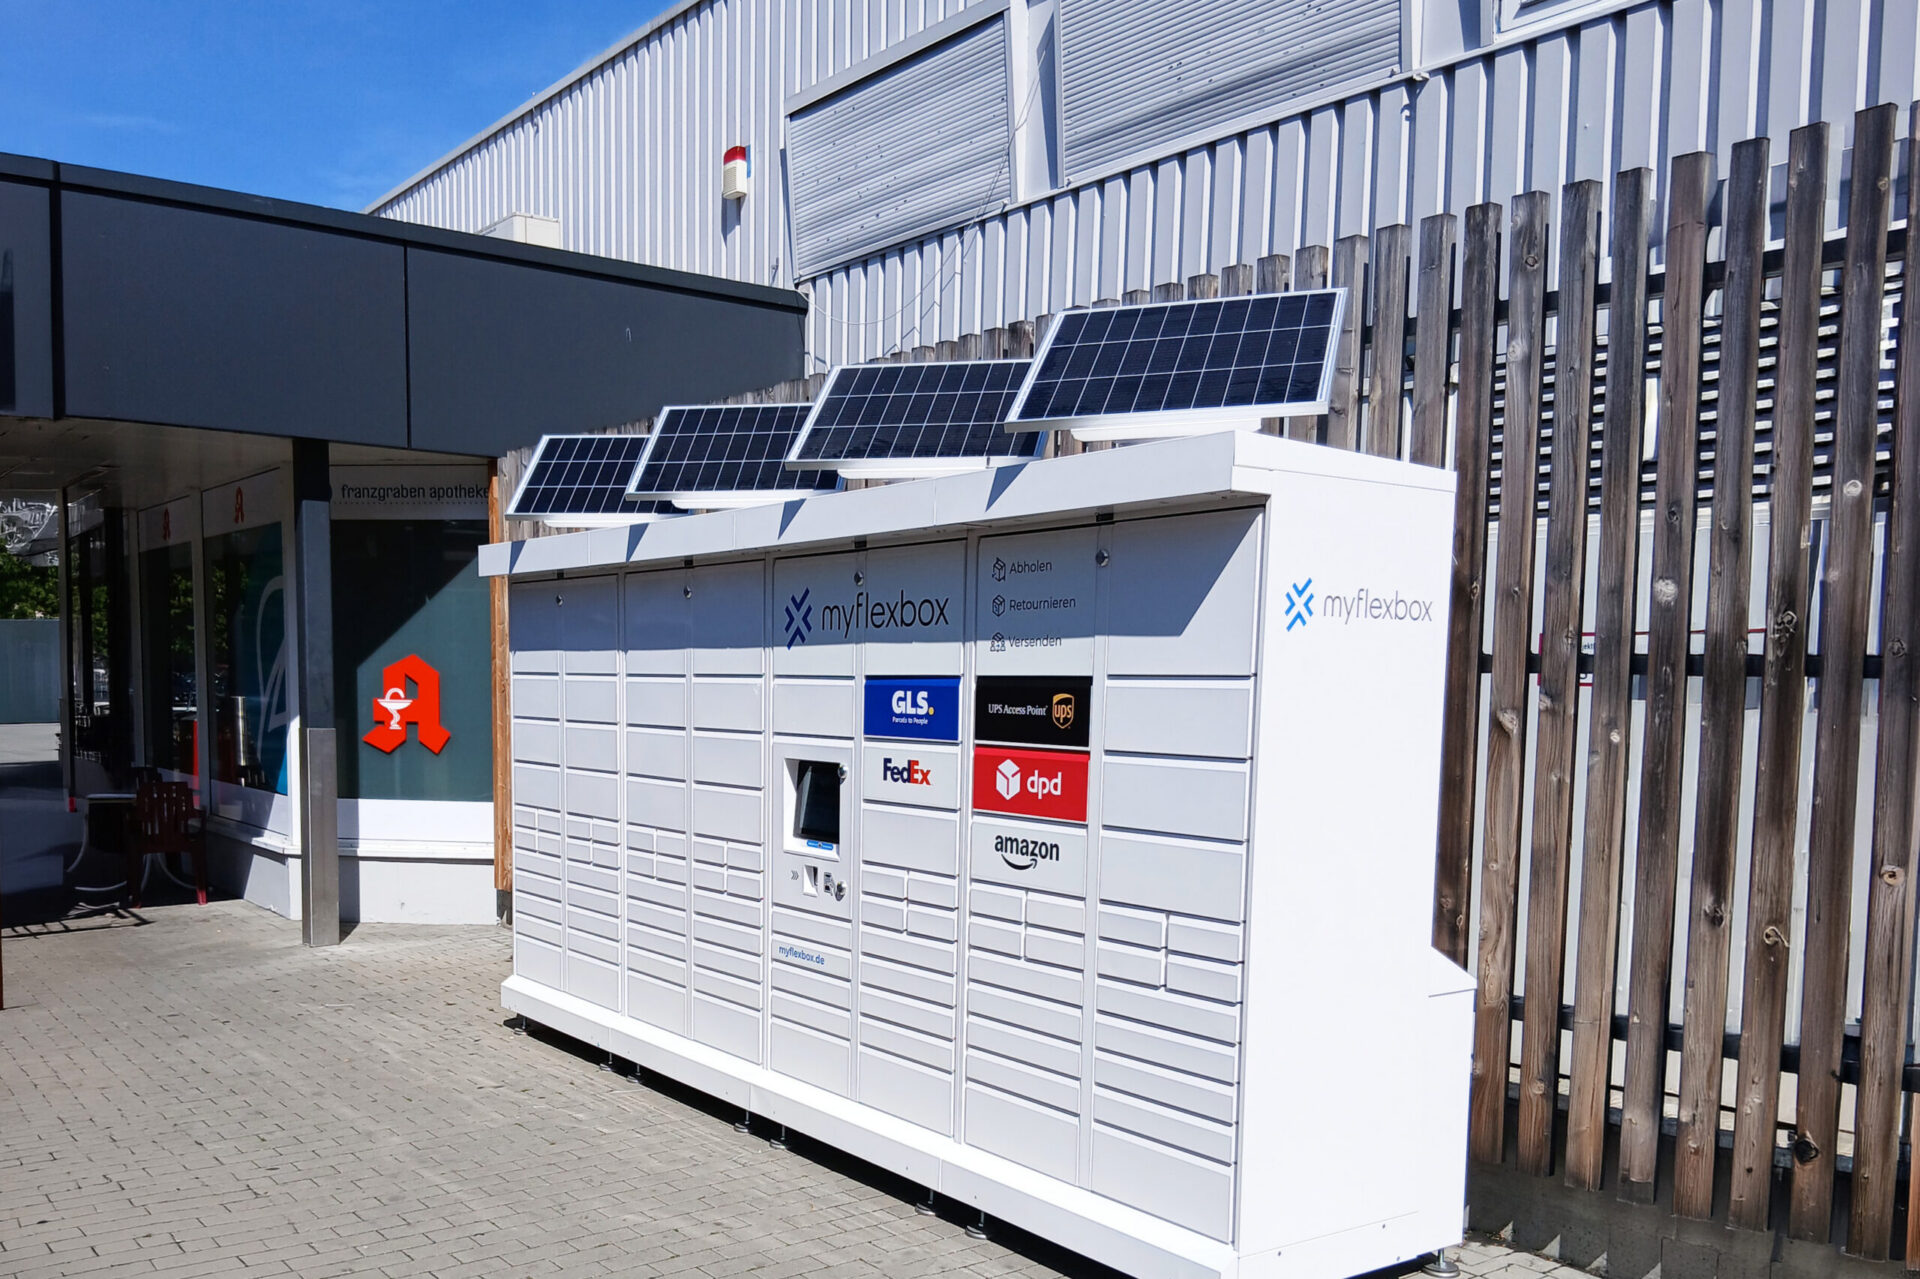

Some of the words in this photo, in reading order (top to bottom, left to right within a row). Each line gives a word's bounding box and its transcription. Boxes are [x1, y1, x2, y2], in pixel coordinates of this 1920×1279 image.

[341, 484, 425, 501] franzgraben
[1009, 560, 1052, 575] Abholen
[1009, 596, 1076, 611] Retournieren
[1323, 588, 1433, 625] myflexbox
[822, 589, 949, 638] myflexbox
[1008, 634, 1062, 648] Versenden
[988, 703, 1003, 714] UPS
[1003, 704, 1026, 715] Access
[1026, 704, 1046, 716] Point
[883, 758, 931, 785] FedEx
[1026, 770, 1062, 800] dpd
[994, 834, 1060, 861] amazon
[779, 946, 825, 965] myflexbox.de
